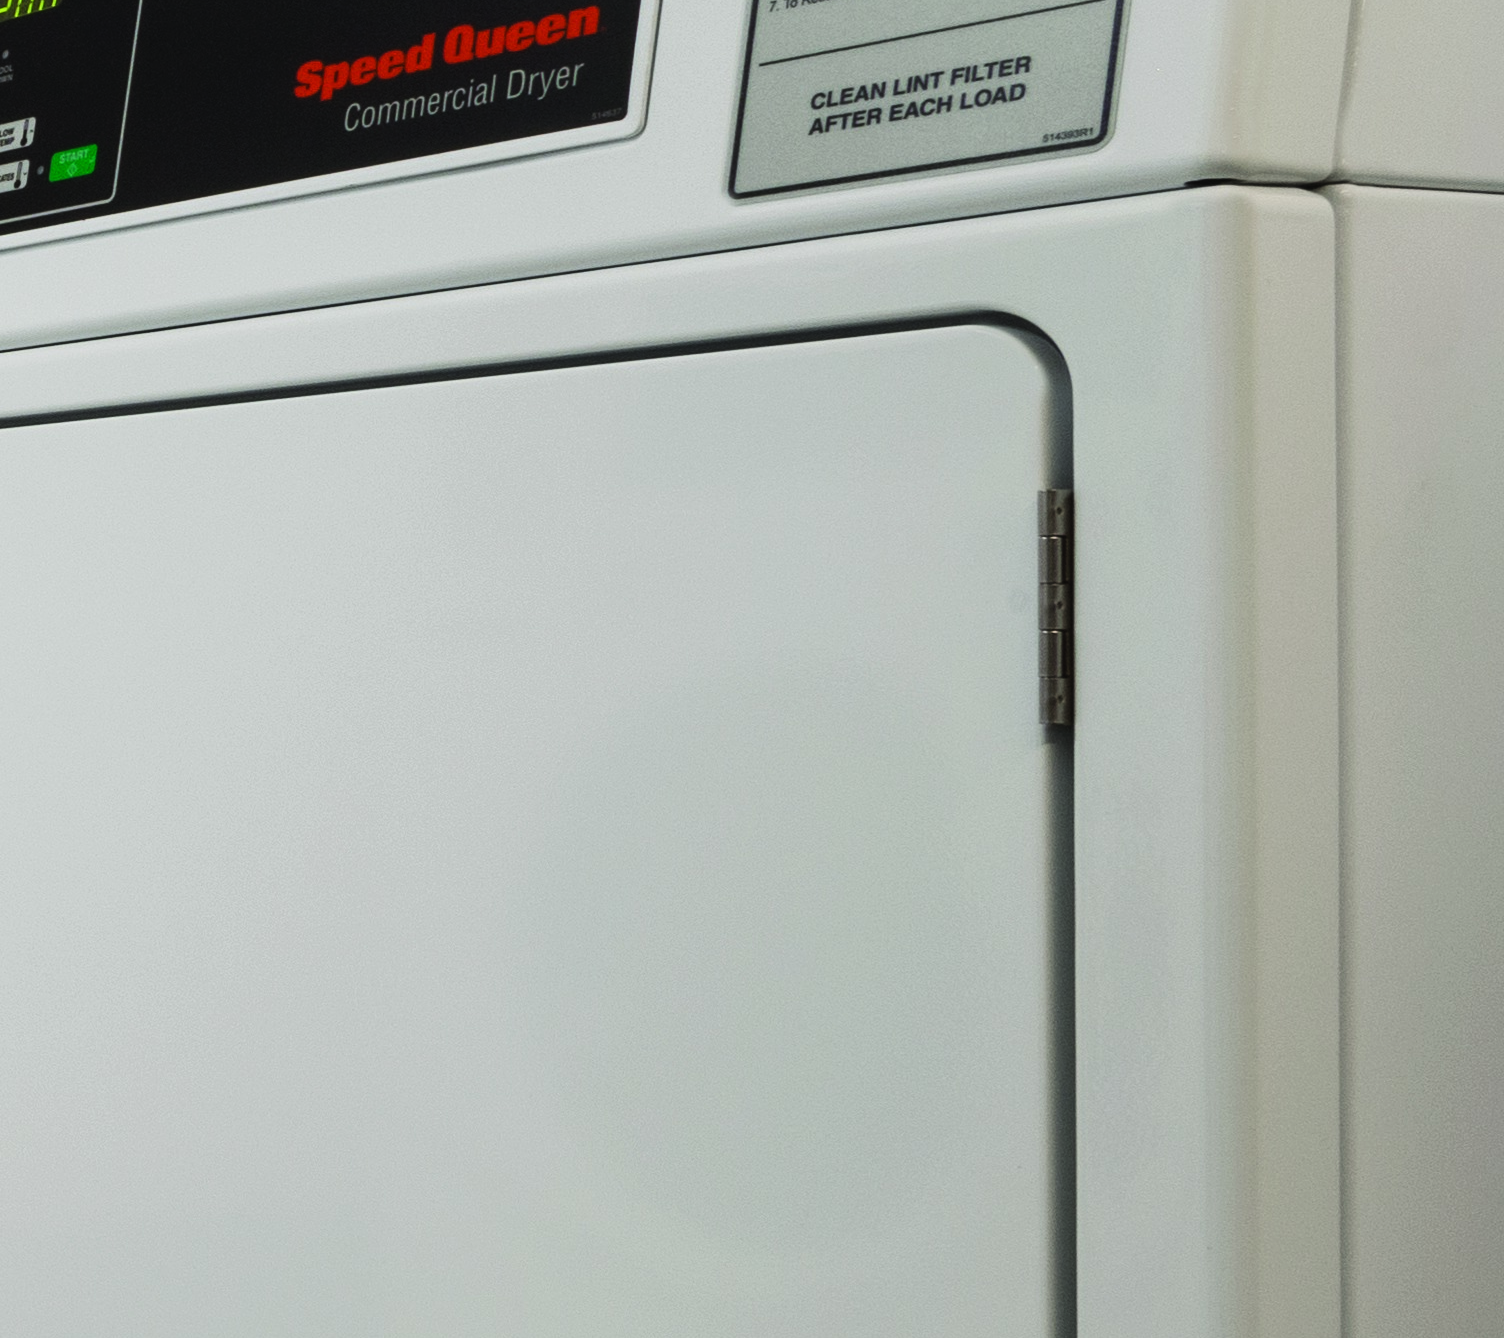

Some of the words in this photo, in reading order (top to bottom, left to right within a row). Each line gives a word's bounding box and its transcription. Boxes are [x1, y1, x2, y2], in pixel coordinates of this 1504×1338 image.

[768, 0, 780, 12] 7.
[294, 32, 435, 101] Speed
[442, 5, 599, 64] Queen
[344, 74, 496, 131] Commercial
[506, 62, 584, 100] Dryer
[807, 106, 882, 135] AFTER
[888, 94, 953, 122] EACH
[959, 82, 1026, 110] LOAD
[810, 81, 886, 110] CLEAN
[892, 70, 945, 96] LINT
[949, 55, 1032, 86] FILTER
[58, 148, 89, 164] START
